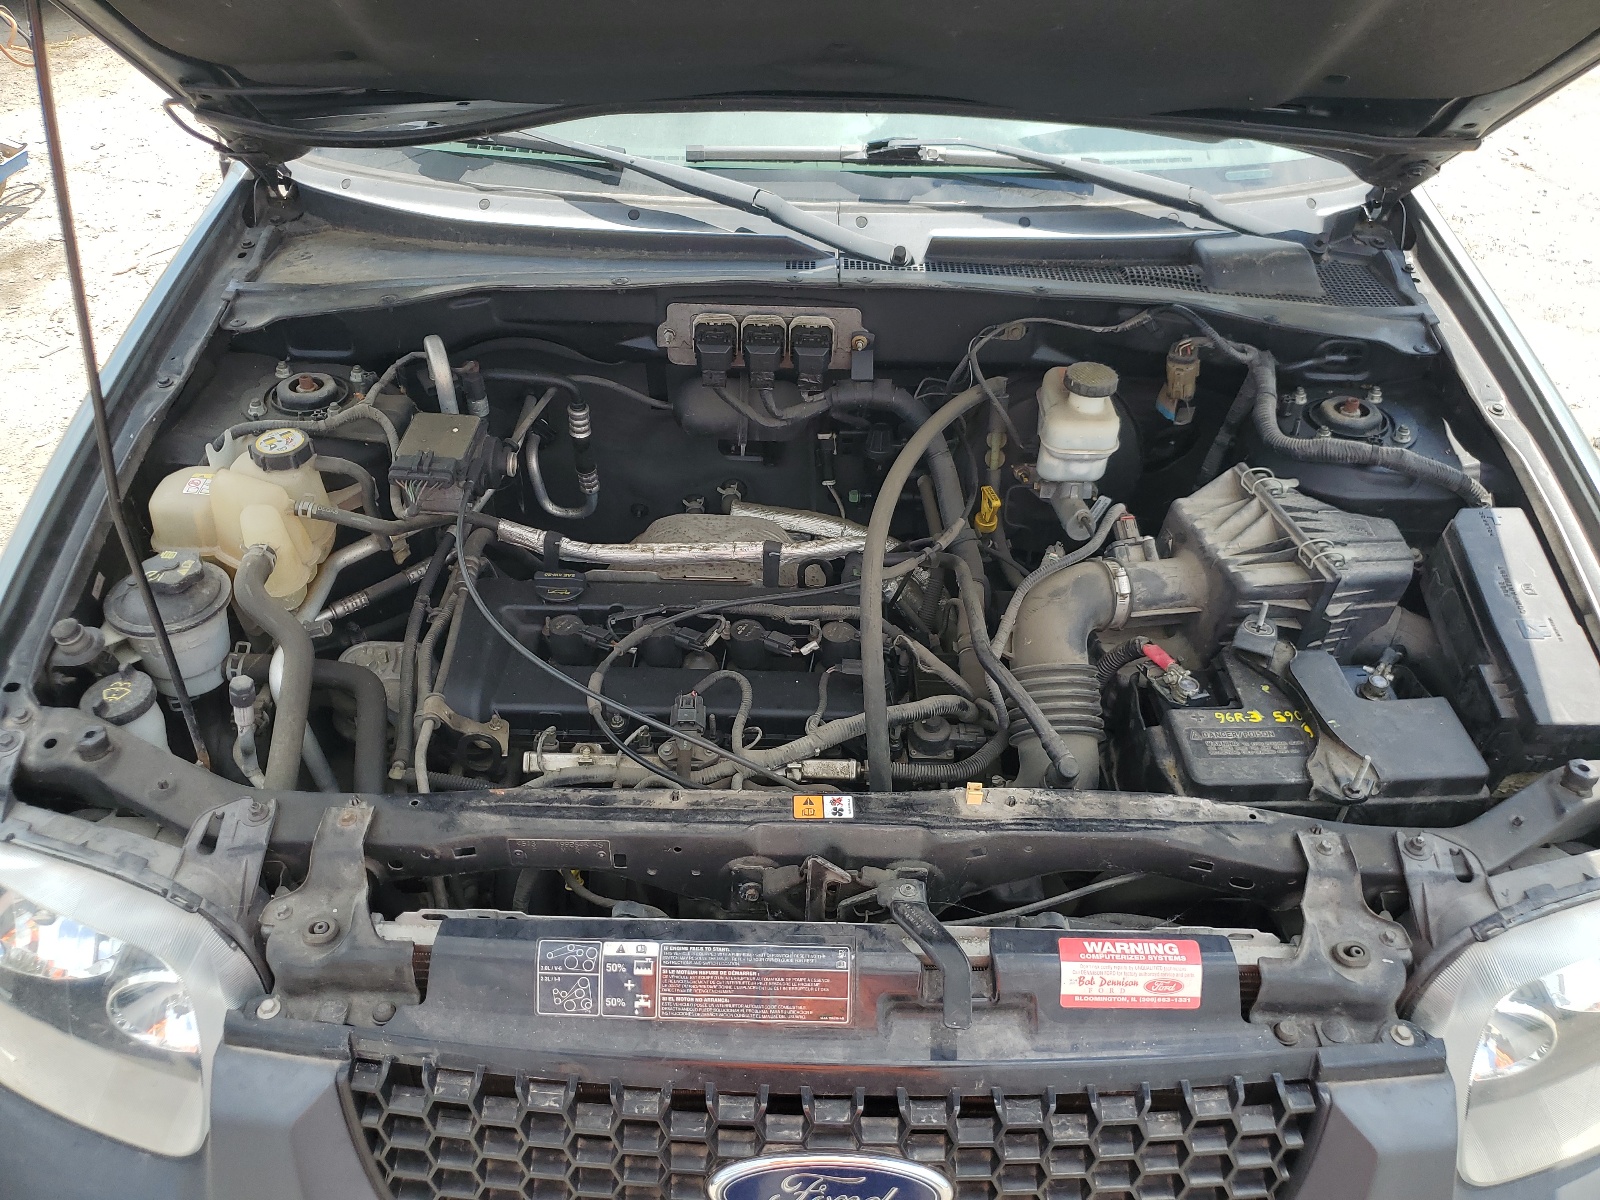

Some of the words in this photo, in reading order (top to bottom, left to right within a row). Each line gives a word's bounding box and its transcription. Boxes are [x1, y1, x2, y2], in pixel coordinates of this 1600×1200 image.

[1083, 941, 1180, 955] WARNING
[1079, 953, 1146, 961] COMPUTERIZED
[1148, 954, 1187, 962] SYSTEMS
[605, 963, 627, 973] 50%
[1078, 975, 1096, 987] Bob
[1099, 976, 1139, 987] Dennison
[1151, 979, 1177, 992] Ford
[605, 997, 626, 1007] 50%
[1074, 995, 1130, 1003] BLOOMINGTON,
